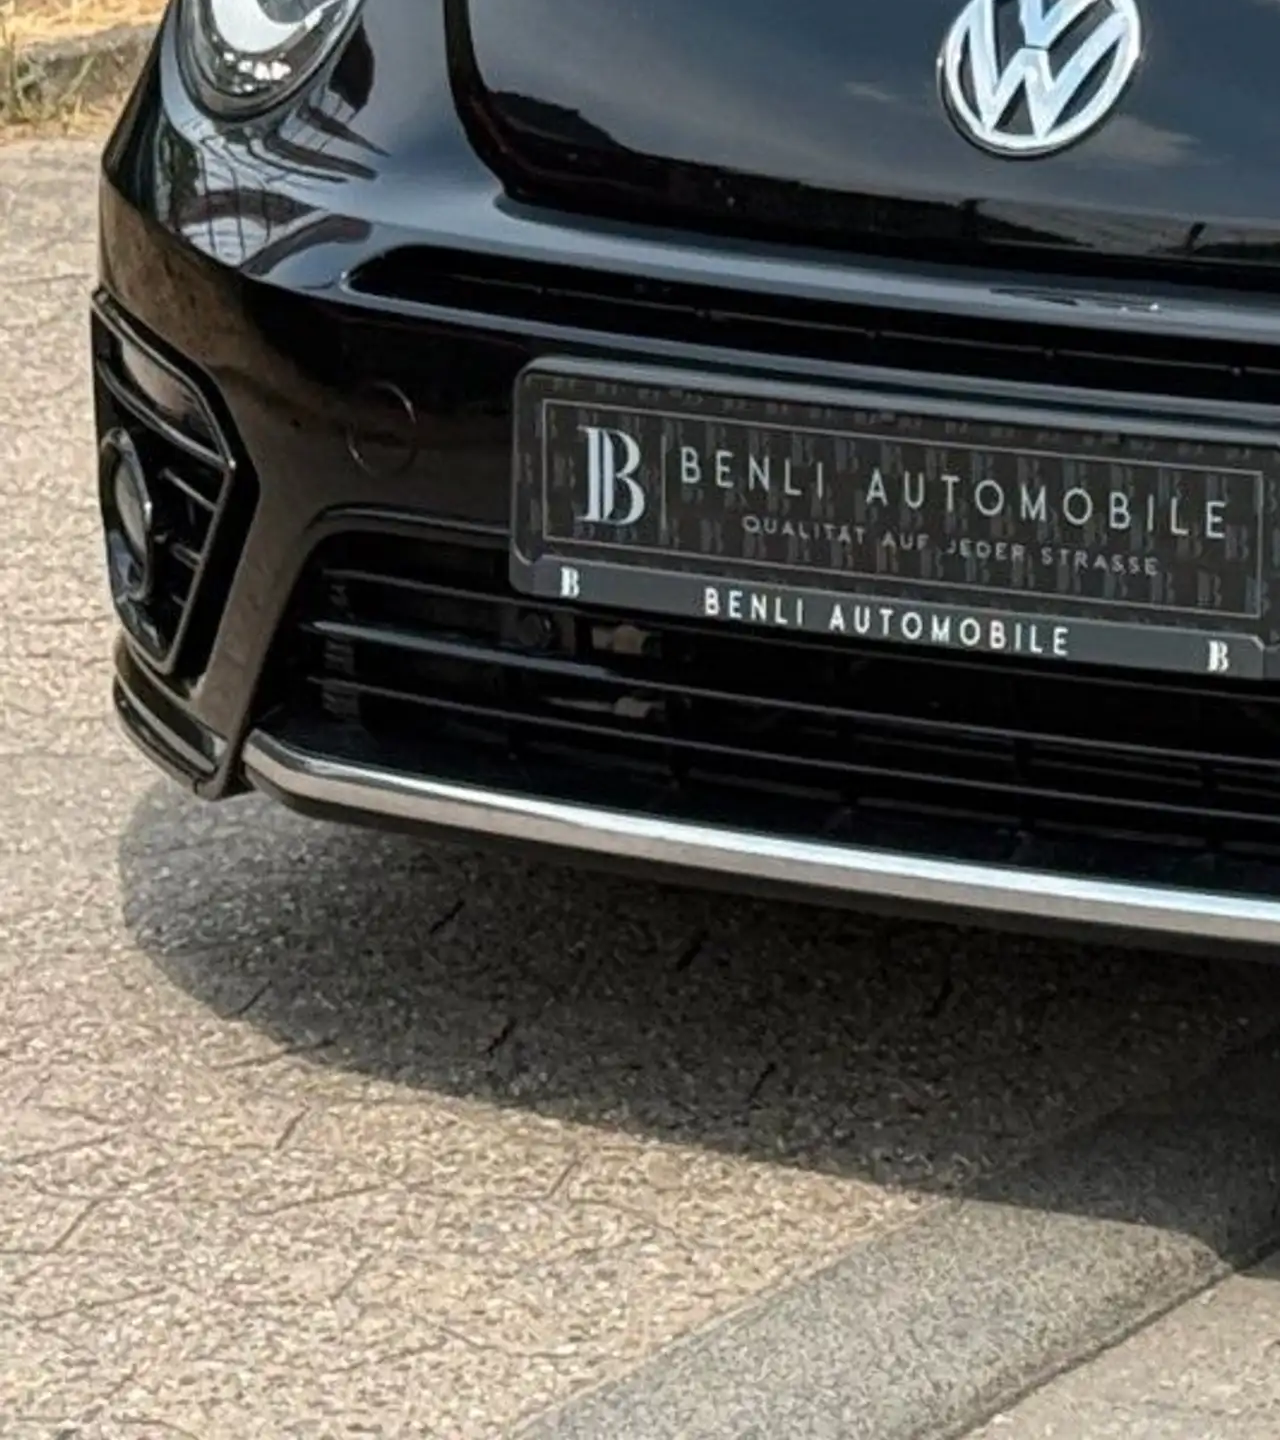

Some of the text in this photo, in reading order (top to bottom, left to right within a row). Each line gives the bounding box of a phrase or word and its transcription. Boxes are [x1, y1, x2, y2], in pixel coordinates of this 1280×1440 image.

[681, 445, 1227, 539] BENLI AUTOMOBILE
[881, 529, 930, 552] AUF
[946, 536, 1026, 562] JEDER
[1040, 545, 1160, 577] STRASSE
[704, 587, 1070, 657] BENLI AUTOMOBILE
